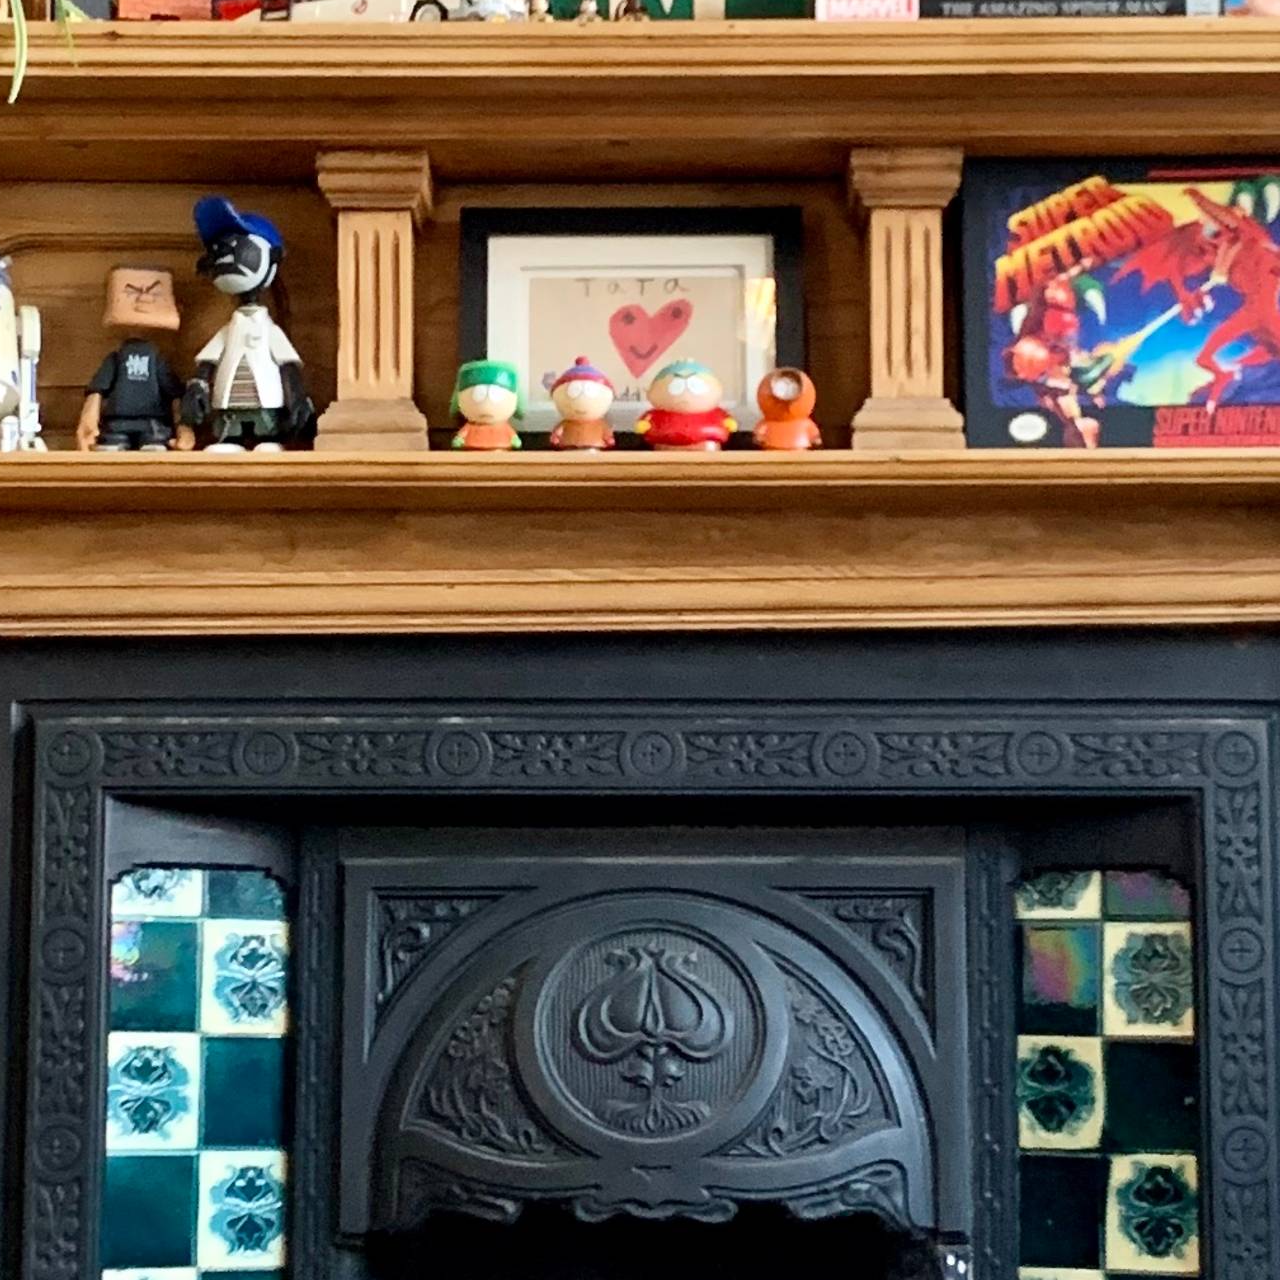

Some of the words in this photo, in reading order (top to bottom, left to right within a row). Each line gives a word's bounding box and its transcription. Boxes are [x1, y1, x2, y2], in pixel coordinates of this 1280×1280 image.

[942, 0, 974, 16] THE
[979, 0, 1059, 16] AMAZING
[1062, 0, 1169, 16] SPIDER-MAN
[1007, 175, 1126, 254] SUPER
[993, 193, 1175, 314] METROID
[1154, 407, 1213, 435] SUPER
